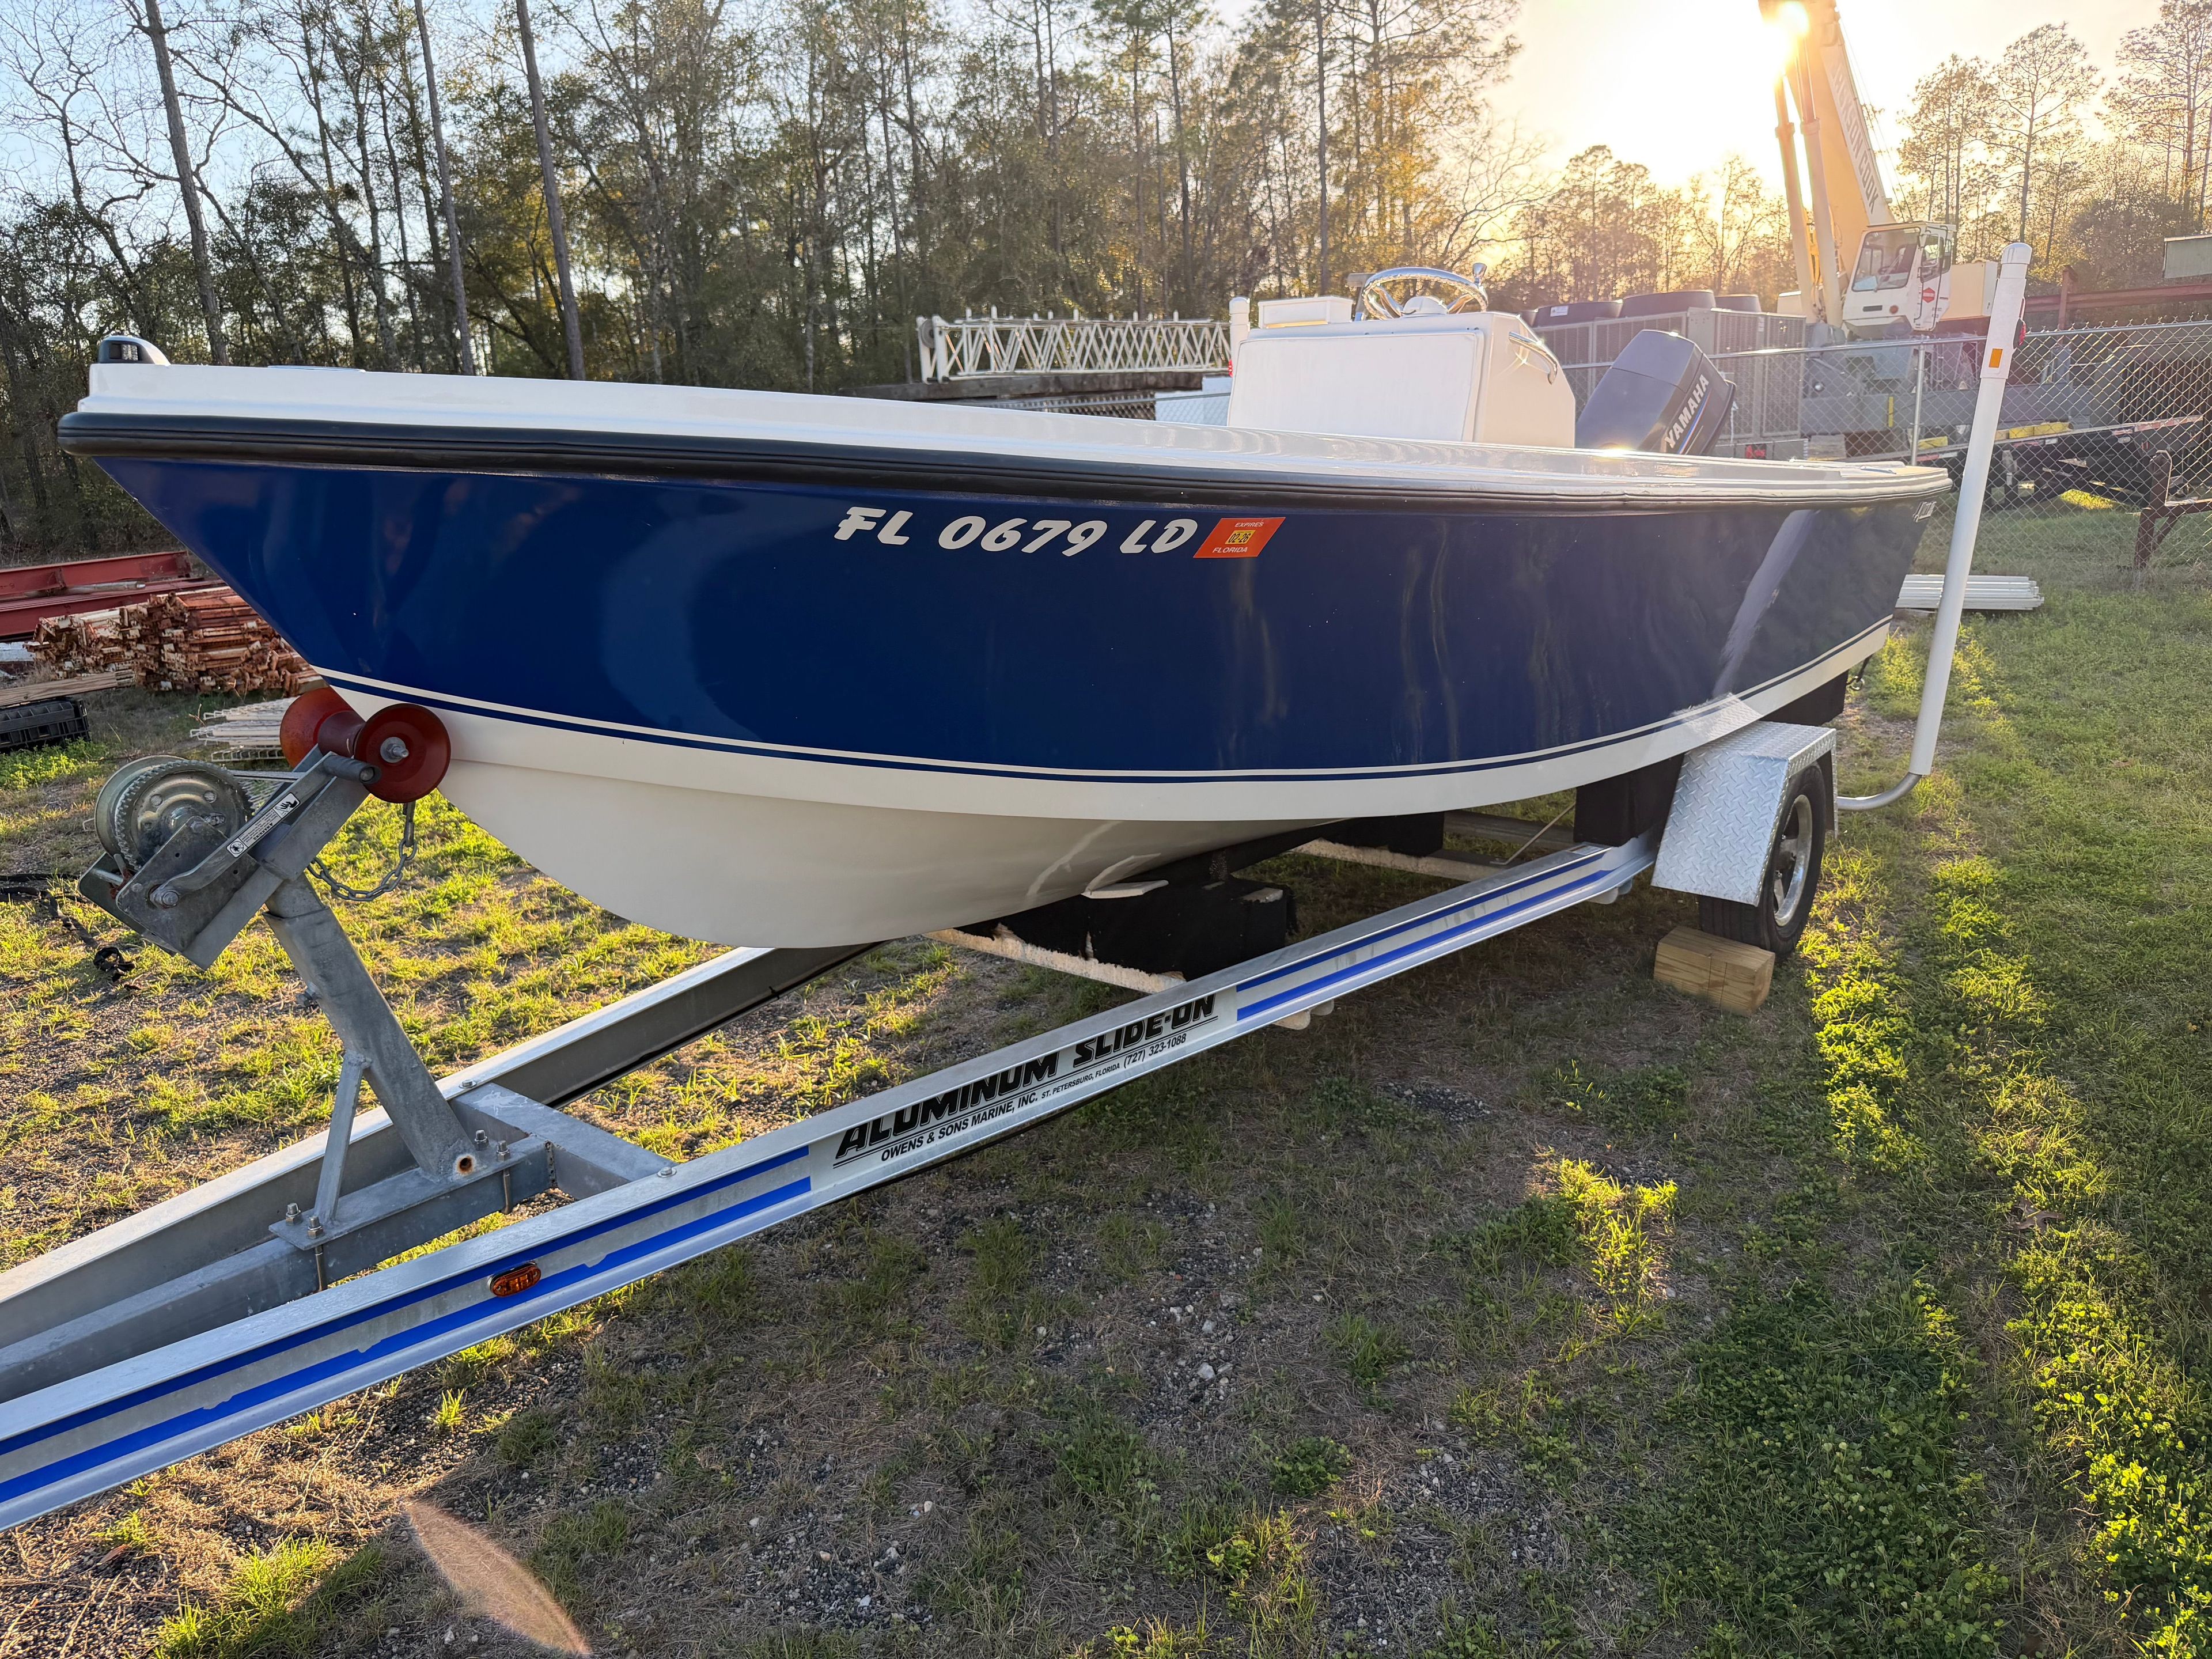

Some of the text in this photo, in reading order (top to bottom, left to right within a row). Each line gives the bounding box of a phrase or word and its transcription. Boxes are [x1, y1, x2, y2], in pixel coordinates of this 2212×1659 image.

[1859, 150, 1878, 214] COOK
[1664, 374, 1709, 448] YAMAHA
[834, 507, 1198, 556] FL 0679 LD
[1228, 533, 1251, 543] 02-26
[253, 824, 271, 840] WARNING
[836, 994, 1216, 1159] ALUMINUM SLIDE-ON
[881, 1033, 1187, 1161] OWENS & SONS MARINE, INC. ST. PETERSBURG, FLORIDA (727) 323-1088
